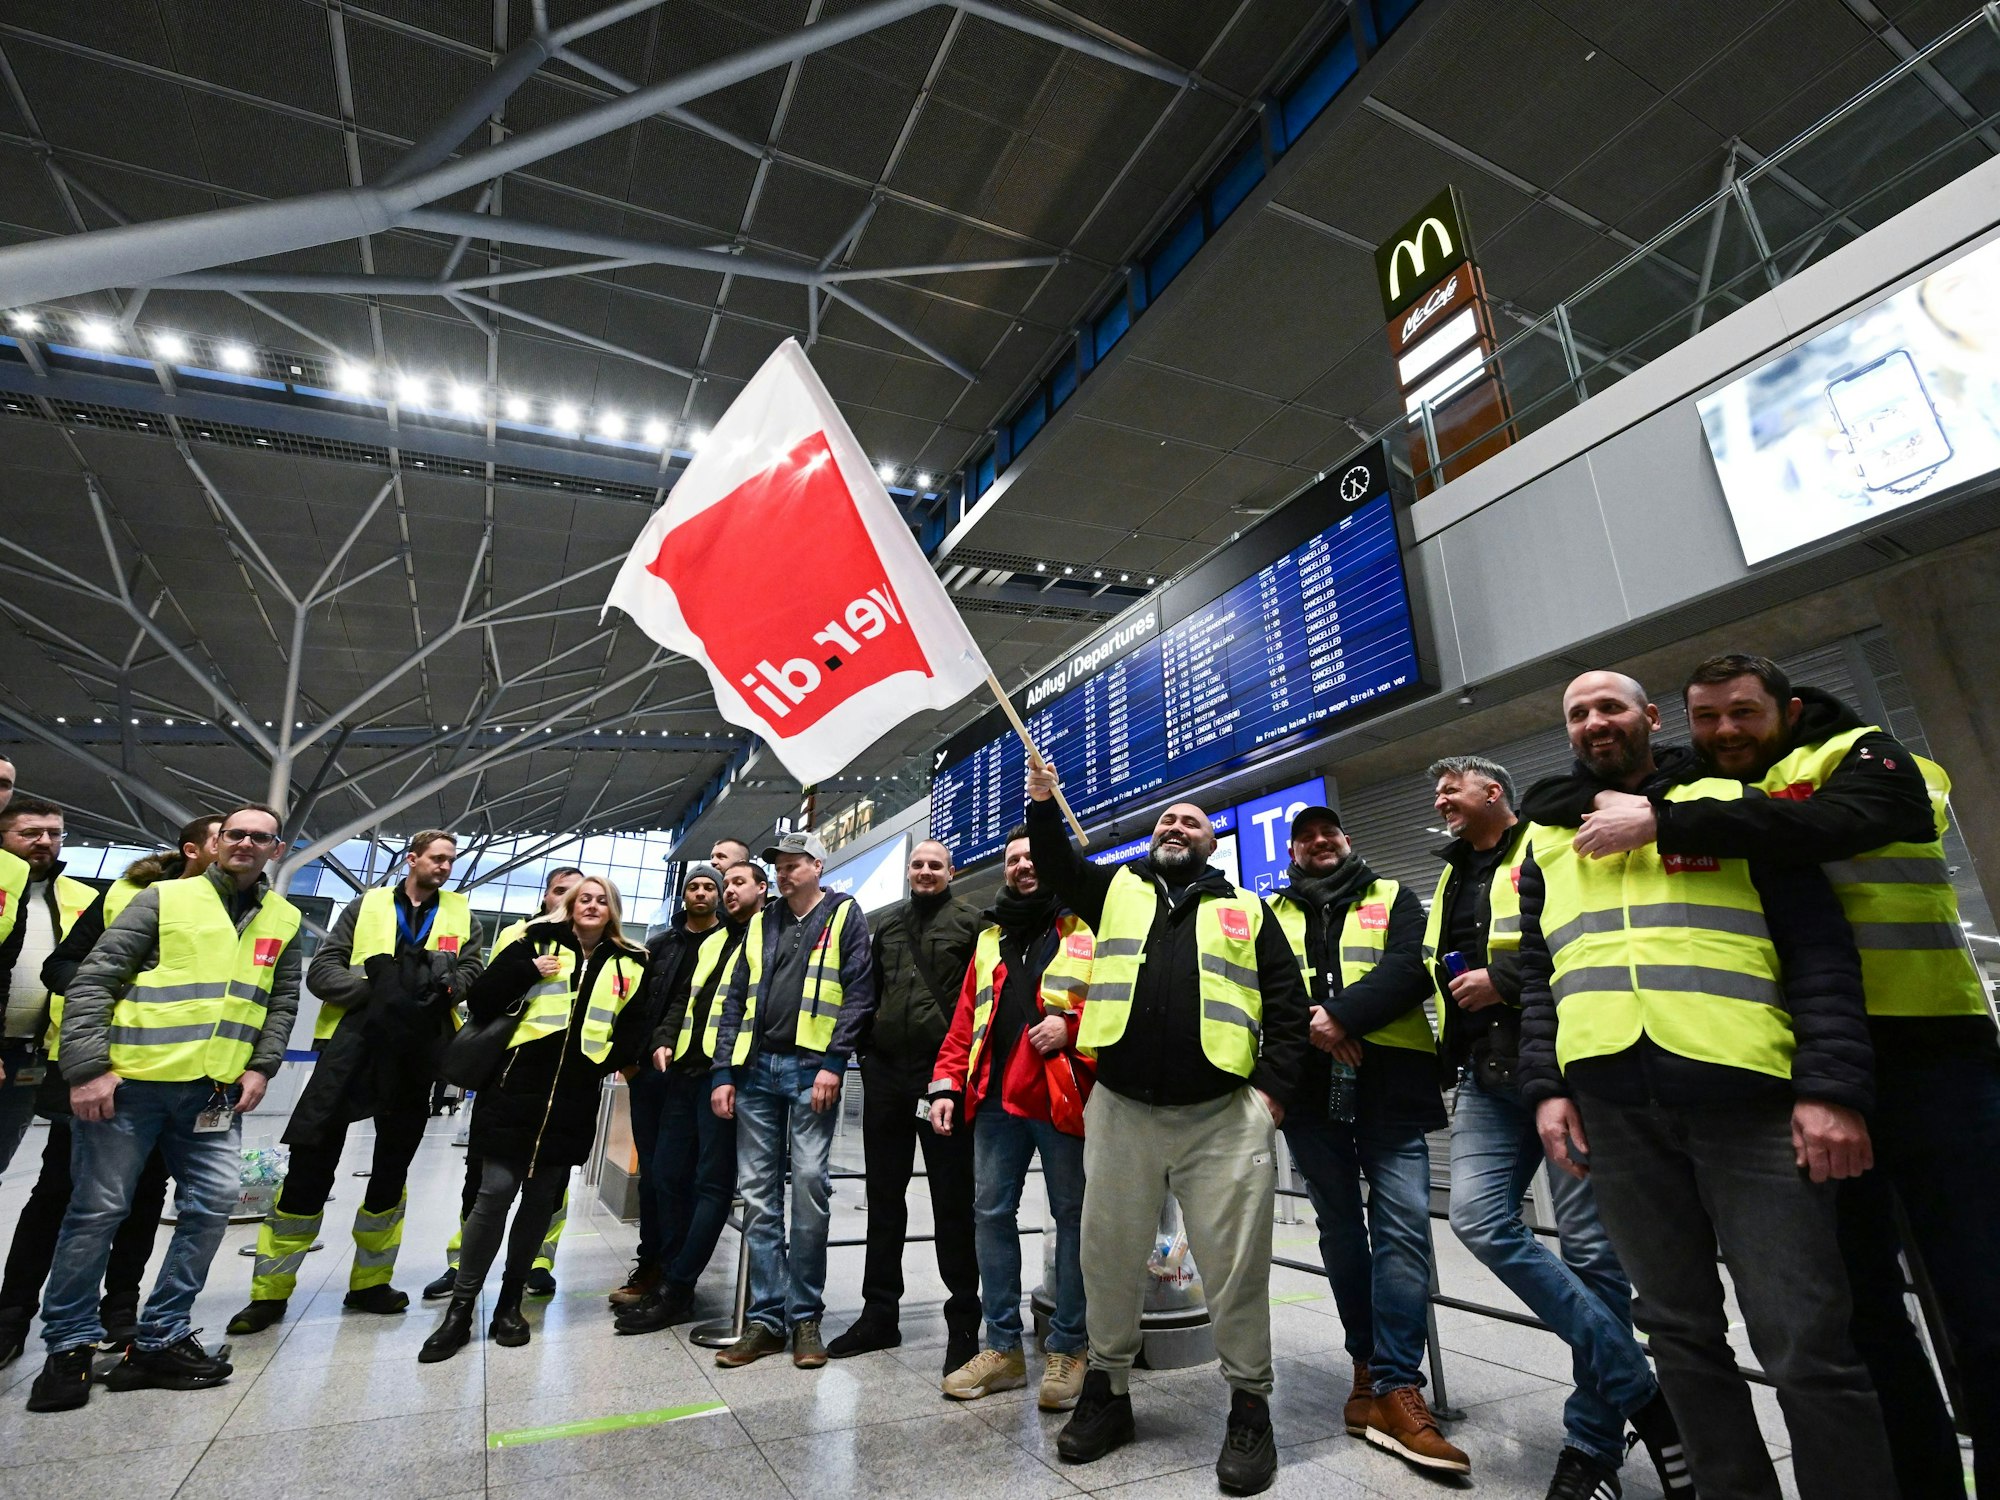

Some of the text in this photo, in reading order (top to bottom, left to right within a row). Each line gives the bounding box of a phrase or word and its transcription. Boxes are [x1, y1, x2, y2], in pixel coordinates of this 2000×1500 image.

[1260, 576, 1276, 589] 10:15
[1298, 543, 1329, 566] CANCELLED
[1300, 554, 1330, 577] CANCELLED
[1301, 566, 1332, 588] CANCELLED
[1191, 655, 1215, 673] FRANKFURT
[1265, 619, 1280, 632] 11:00
[1304, 589, 1335, 611] CANCELLED
[1212, 634, 1235, 651] MALLORCA
[1264, 608, 1279, 621] 11:00
[1302, 577, 1333, 600] CANCELLED
[1266, 630, 1281, 643] 11:00
[1305, 601, 1336, 622] CANCELLED
[1267, 641, 1283, 654] 11:20
[1306, 612, 1338, 634] CANCELLED
[1308, 624, 1340, 645] CANCELLED
[1026, 671, 1066, 709] Abflug
[1074, 612, 1156, 677] Departures
[1269, 664, 1285, 676] 12:00
[1309, 636, 1341, 657] CANCELLED
[1270, 675, 1286, 688] 12:15
[1310, 648, 1343, 669] CANCELLED
[1195, 723, 1212, 735] LONDON
[1271, 687, 1287, 700] 13:00
[1312, 661, 1344, 681] CANCELLED
[1264, 727, 1288, 740] Freitag
[1289, 717, 1307, 730] keine
[1308, 708, 1328, 722] Flüge
[1329, 699, 1349, 713] wegen
[1350, 689, 1376, 704] Streik
[1377, 682, 1391, 693] von
[1393, 675, 1406, 686] ver
[1272, 699, 1289, 711] 13:05
[1313, 673, 1346, 694] CANCELLED
[1119, 790, 1133, 800] Friday
[1223, 923, 1248, 936] ver.di
[1361, 917, 1387, 926] ver.di
[1067, 946, 1091, 957] ver.di
